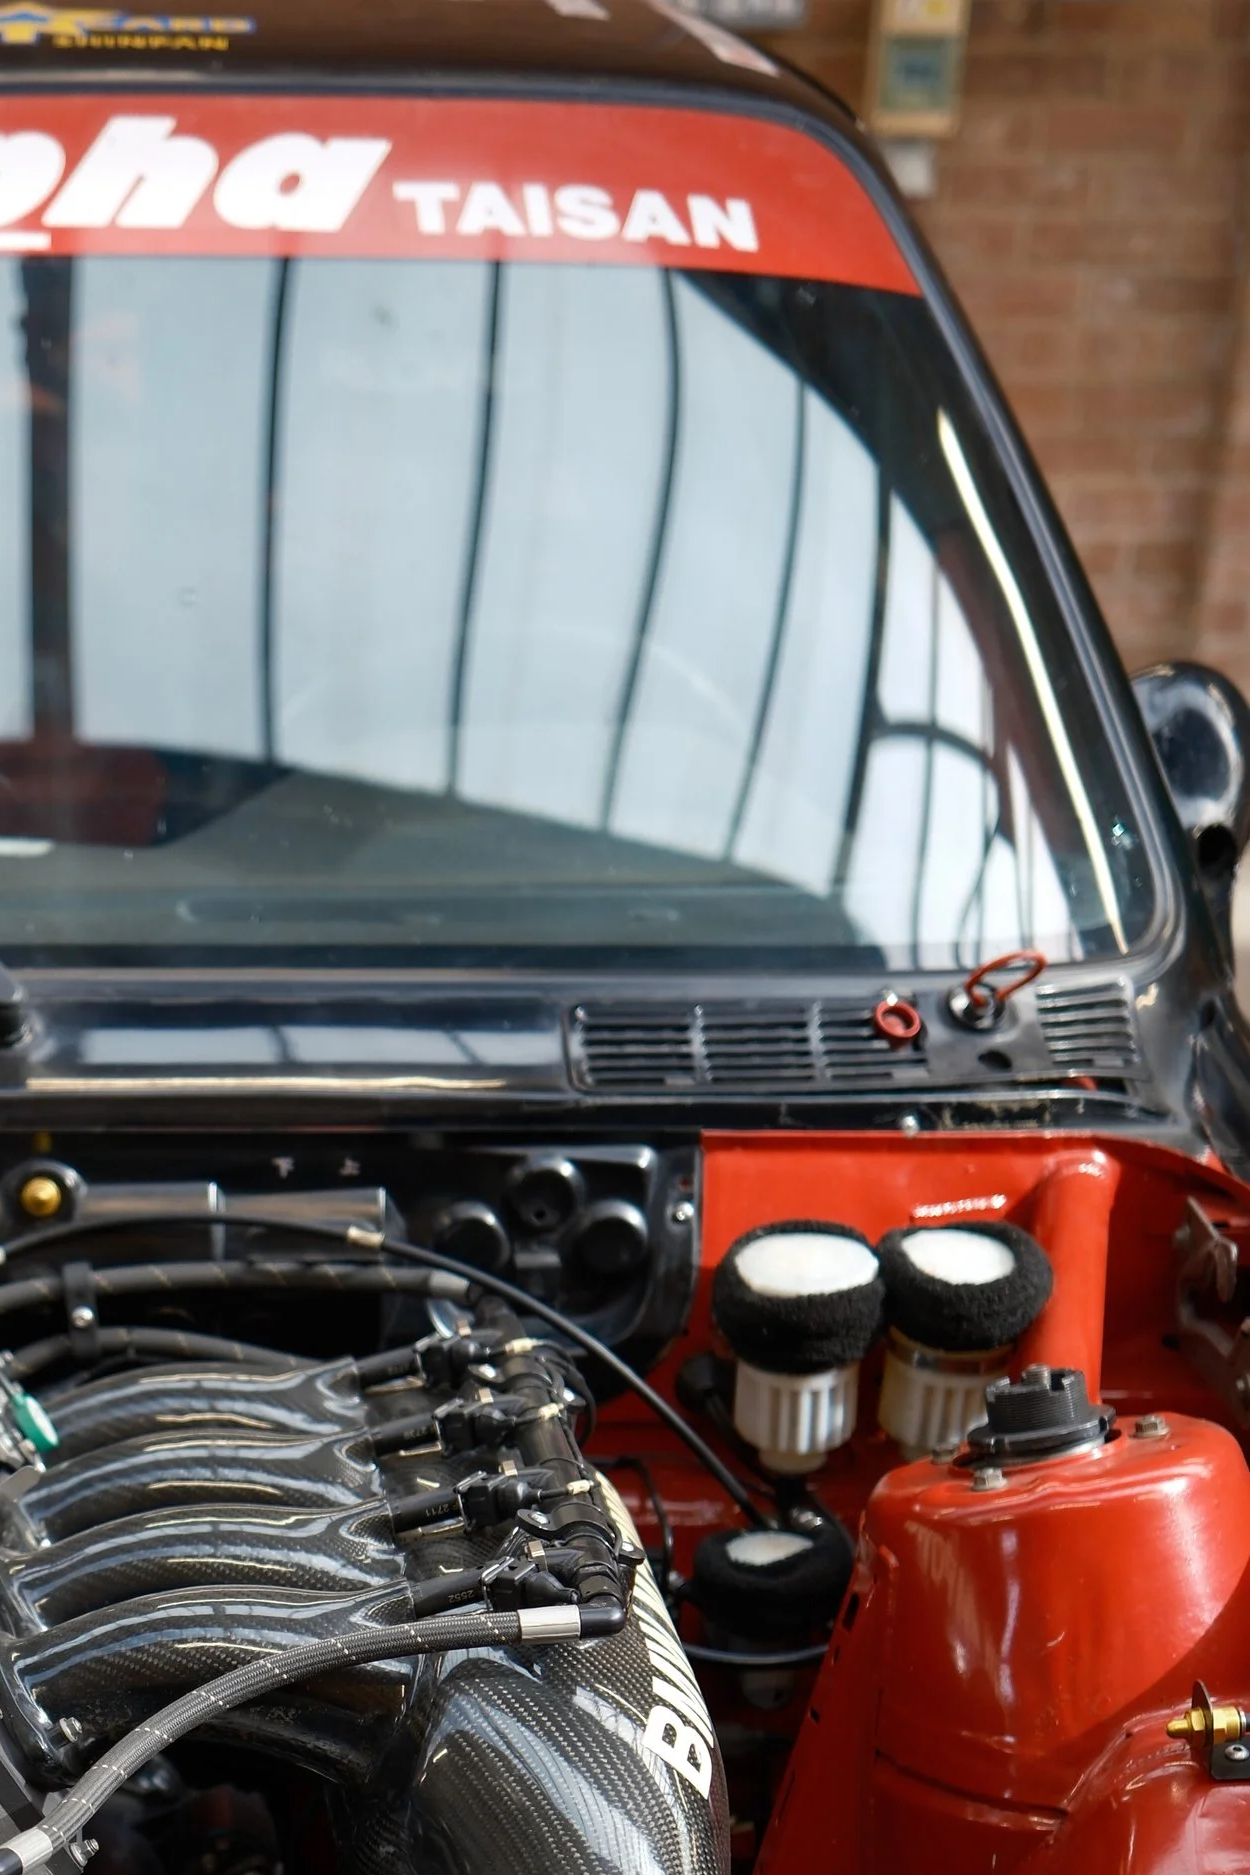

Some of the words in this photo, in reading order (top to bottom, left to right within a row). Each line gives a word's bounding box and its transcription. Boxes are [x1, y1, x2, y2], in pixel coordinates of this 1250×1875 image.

[392, 180, 759, 253] TAISAN
[425, 1503, 450, 1517] 2711
[448, 1588, 475, 1603] 2552
